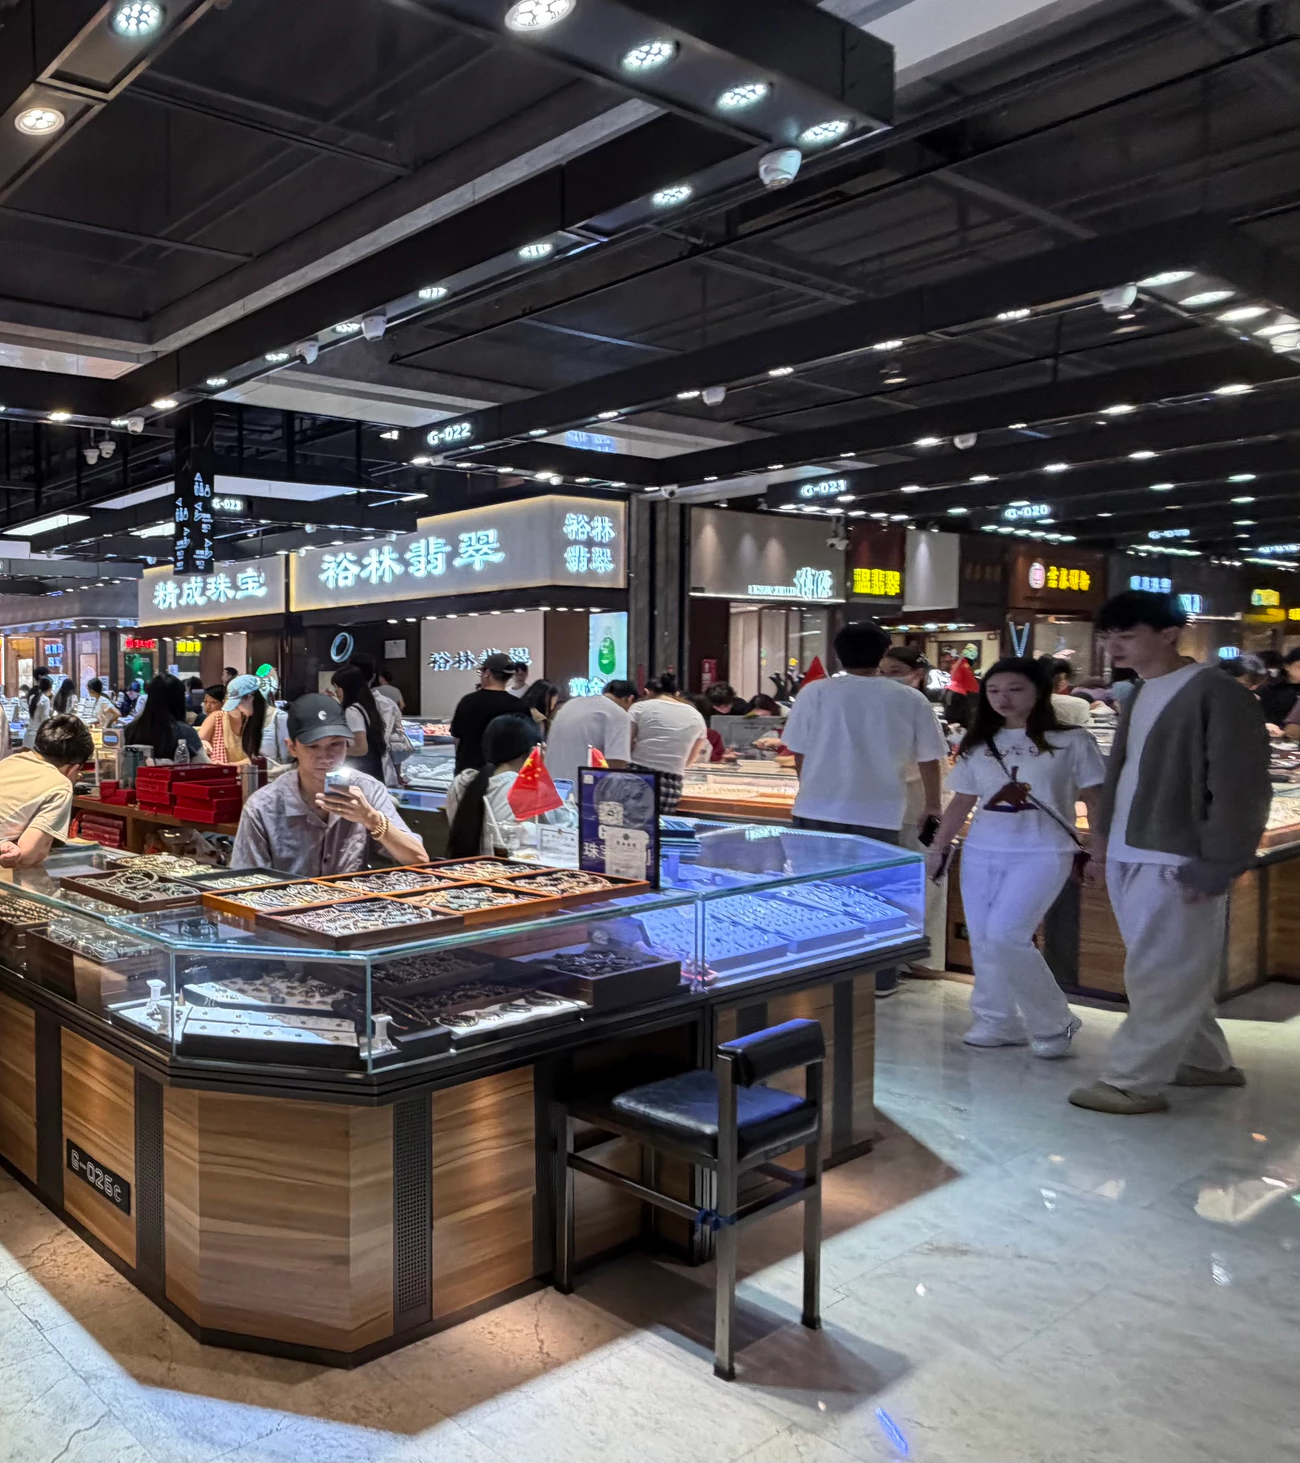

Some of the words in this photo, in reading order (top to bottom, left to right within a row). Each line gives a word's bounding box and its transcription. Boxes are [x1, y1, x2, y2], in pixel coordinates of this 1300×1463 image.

[427, 422, 472, 446] G-022
[801, 479, 848, 497] G-021
[563, 512, 617, 543] 裕林
[318, 528, 505, 590] 裕林翡翠
[563, 545, 616, 574] 翡翠
[152, 566, 268, 610] 精成珠宝
